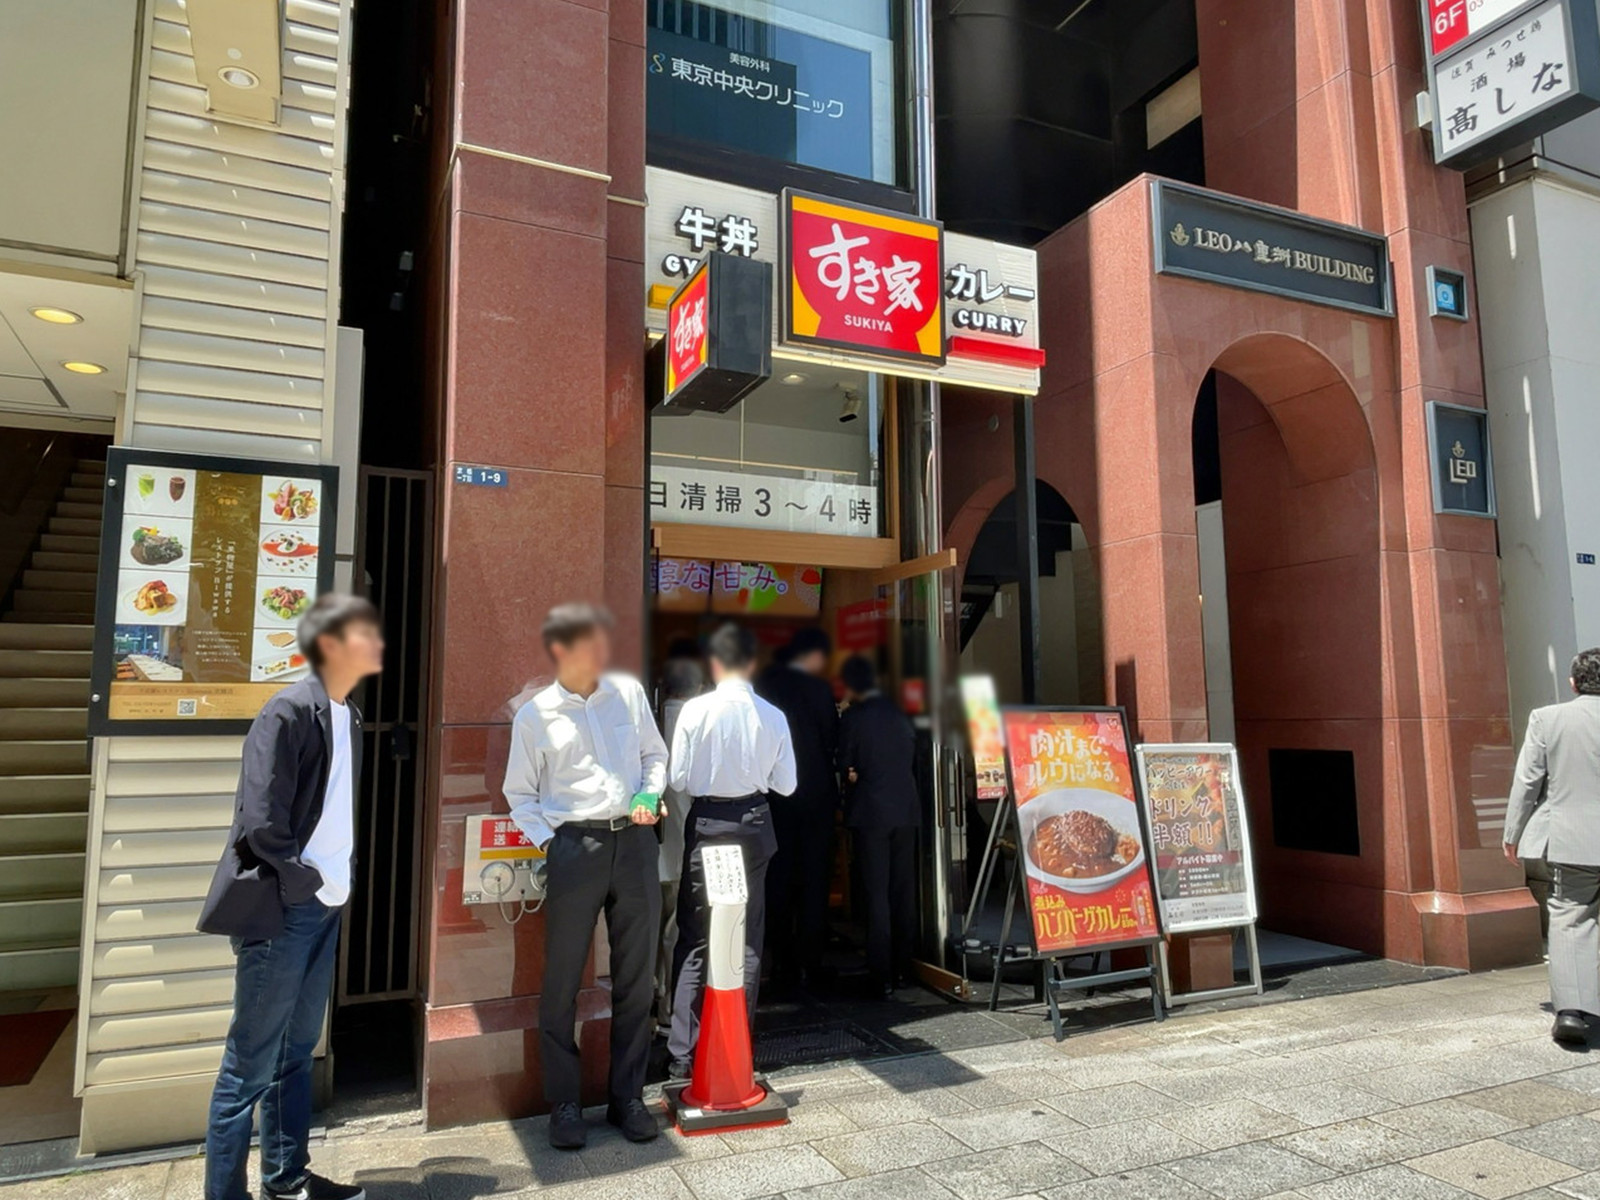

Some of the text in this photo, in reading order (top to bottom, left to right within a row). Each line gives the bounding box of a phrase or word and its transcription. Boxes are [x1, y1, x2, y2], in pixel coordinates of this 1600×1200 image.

[1434, 1, 1464, 34] 6F
[729, 52, 770, 73] 美容外科
[1470, 52, 1526, 92] 酒場
[671, 57, 844, 118] 東京中央クリニック
[678, 207, 758, 258] 牛丼
[809, 223, 923, 316] すき家
[949, 264, 1035, 304] カレー
[843, 314, 894, 333] SUKIYA
[955, 308, 1027, 336] CURRY
[480, 471, 501, 484] 1-9
[1025, 759, 1120, 787] ルウになる。
[1151, 796, 1211, 821] ドリンク
[1037, 905, 1132, 939] ハンバーグカレー
